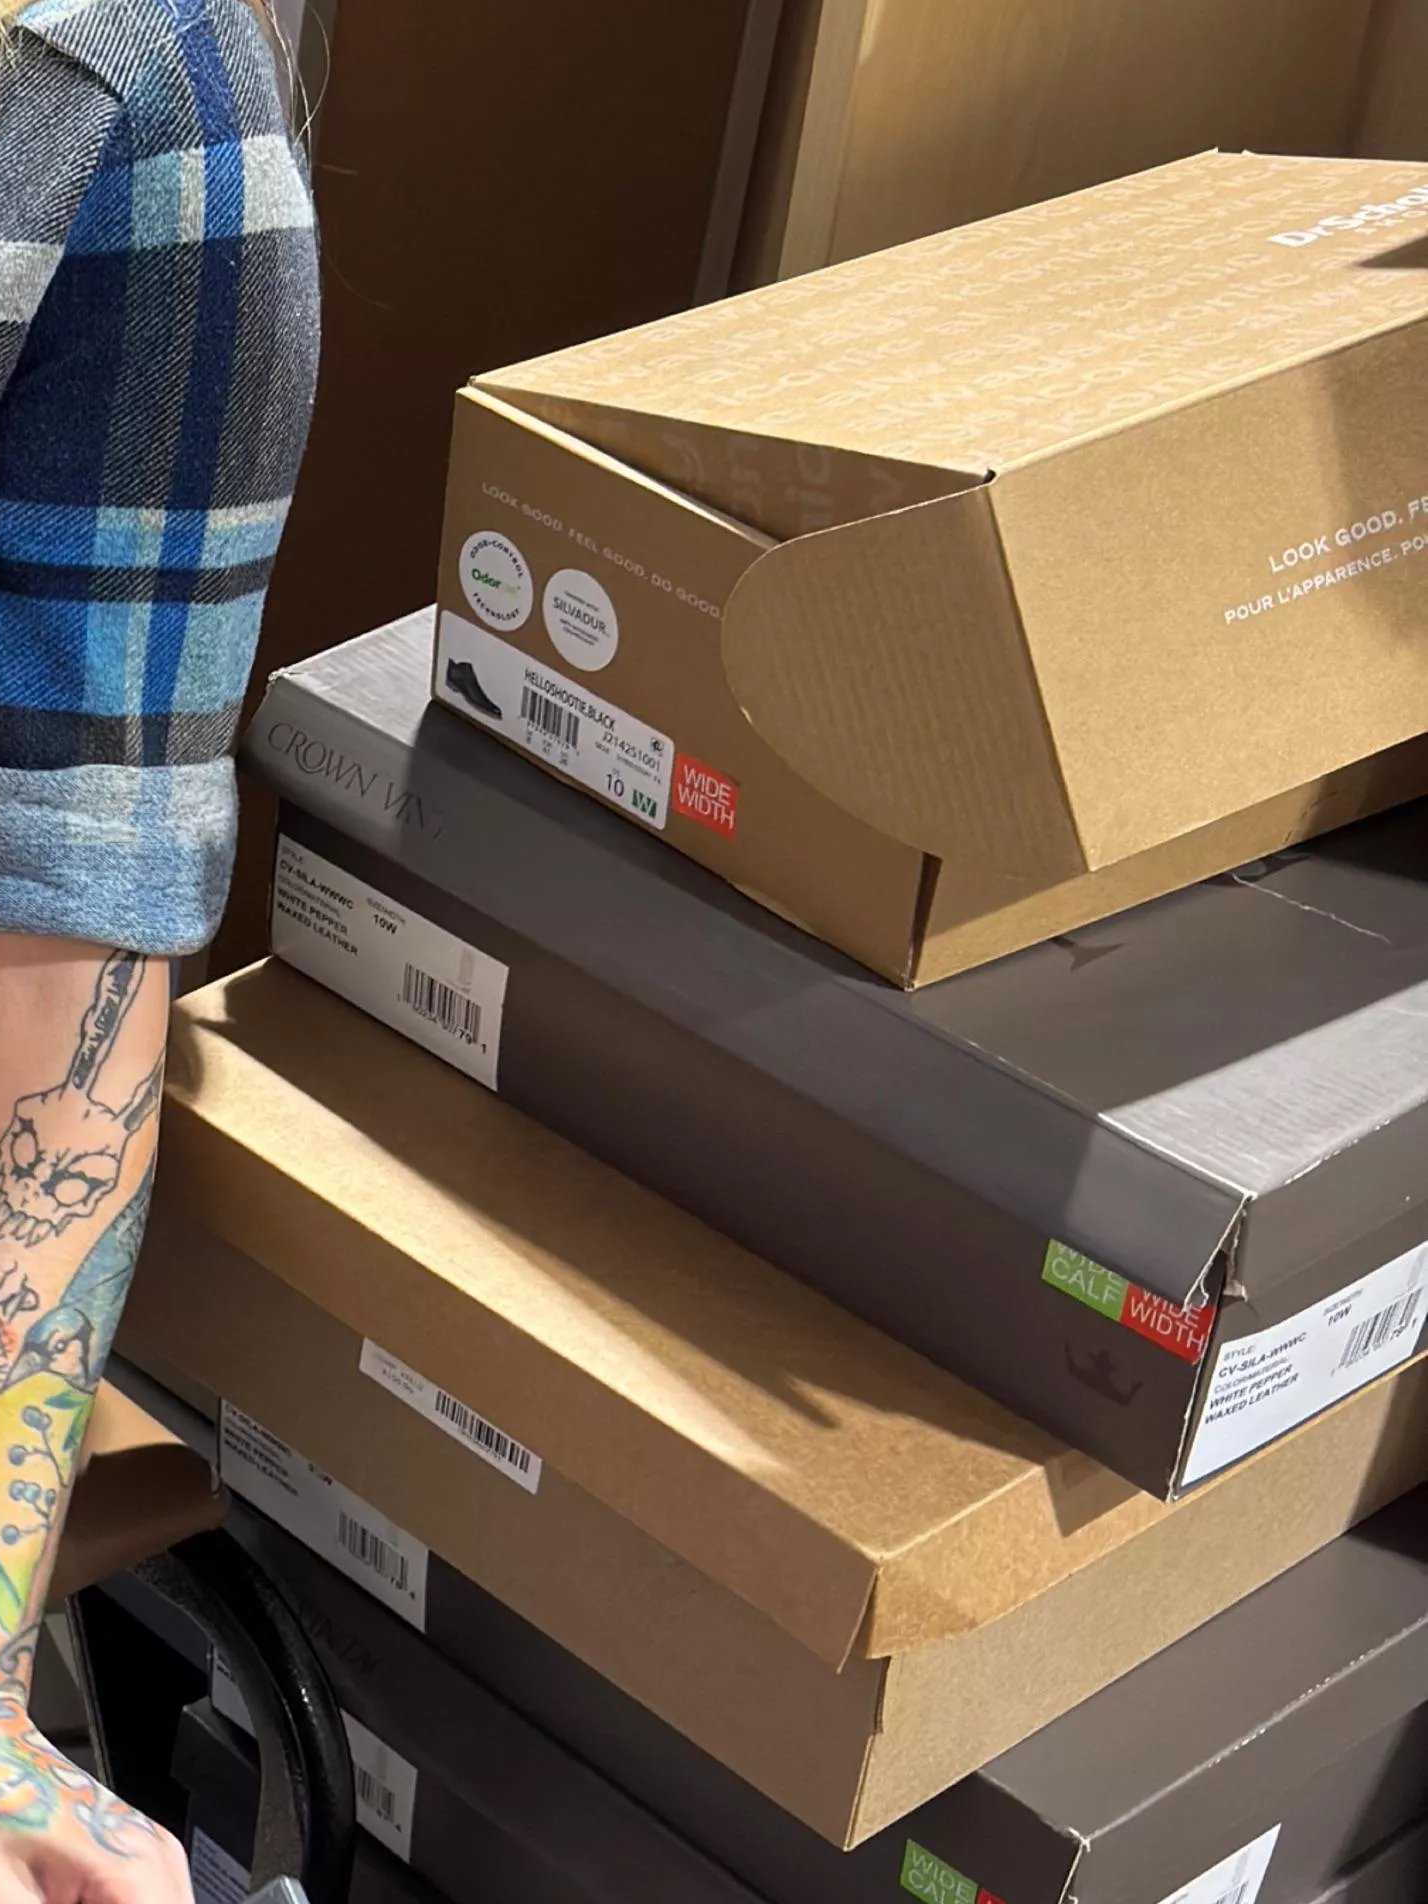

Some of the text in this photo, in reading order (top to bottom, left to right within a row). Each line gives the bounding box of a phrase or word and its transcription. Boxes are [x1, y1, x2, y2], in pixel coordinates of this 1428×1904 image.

[481, 481, 519, 509] LOOK
[568, 527, 598, 554] FEEL
[651, 572, 673, 593] DO
[1268, 534, 1331, 573] LOOK
[1334, 509, 1404, 548] GOOD.
[1223, 593, 1276, 626] POUR
[1277, 547, 1399, 605] L'APPARENCE.
[268, 721, 379, 799] CROWN
[605, 773, 625, 798] 10
[676, 783, 736, 830] WIDTH
[682, 763, 733, 807] WIDE
[308, 902, 349, 935] PEPPER
[312, 920, 360, 957] LEATHER
[372, 912, 398, 936] 10W
[1050, 1258, 1121, 1306] CALF
[1129, 1299, 1206, 1351] WIDTH
[1328, 1304, 1353, 1327] 10W
[1204, 1373, 1300, 1425] WAXED LEATHER
[1209, 1364, 1293, 1410] WHITE PEPPER
[911, 1847, 971, 1896] WIDE
